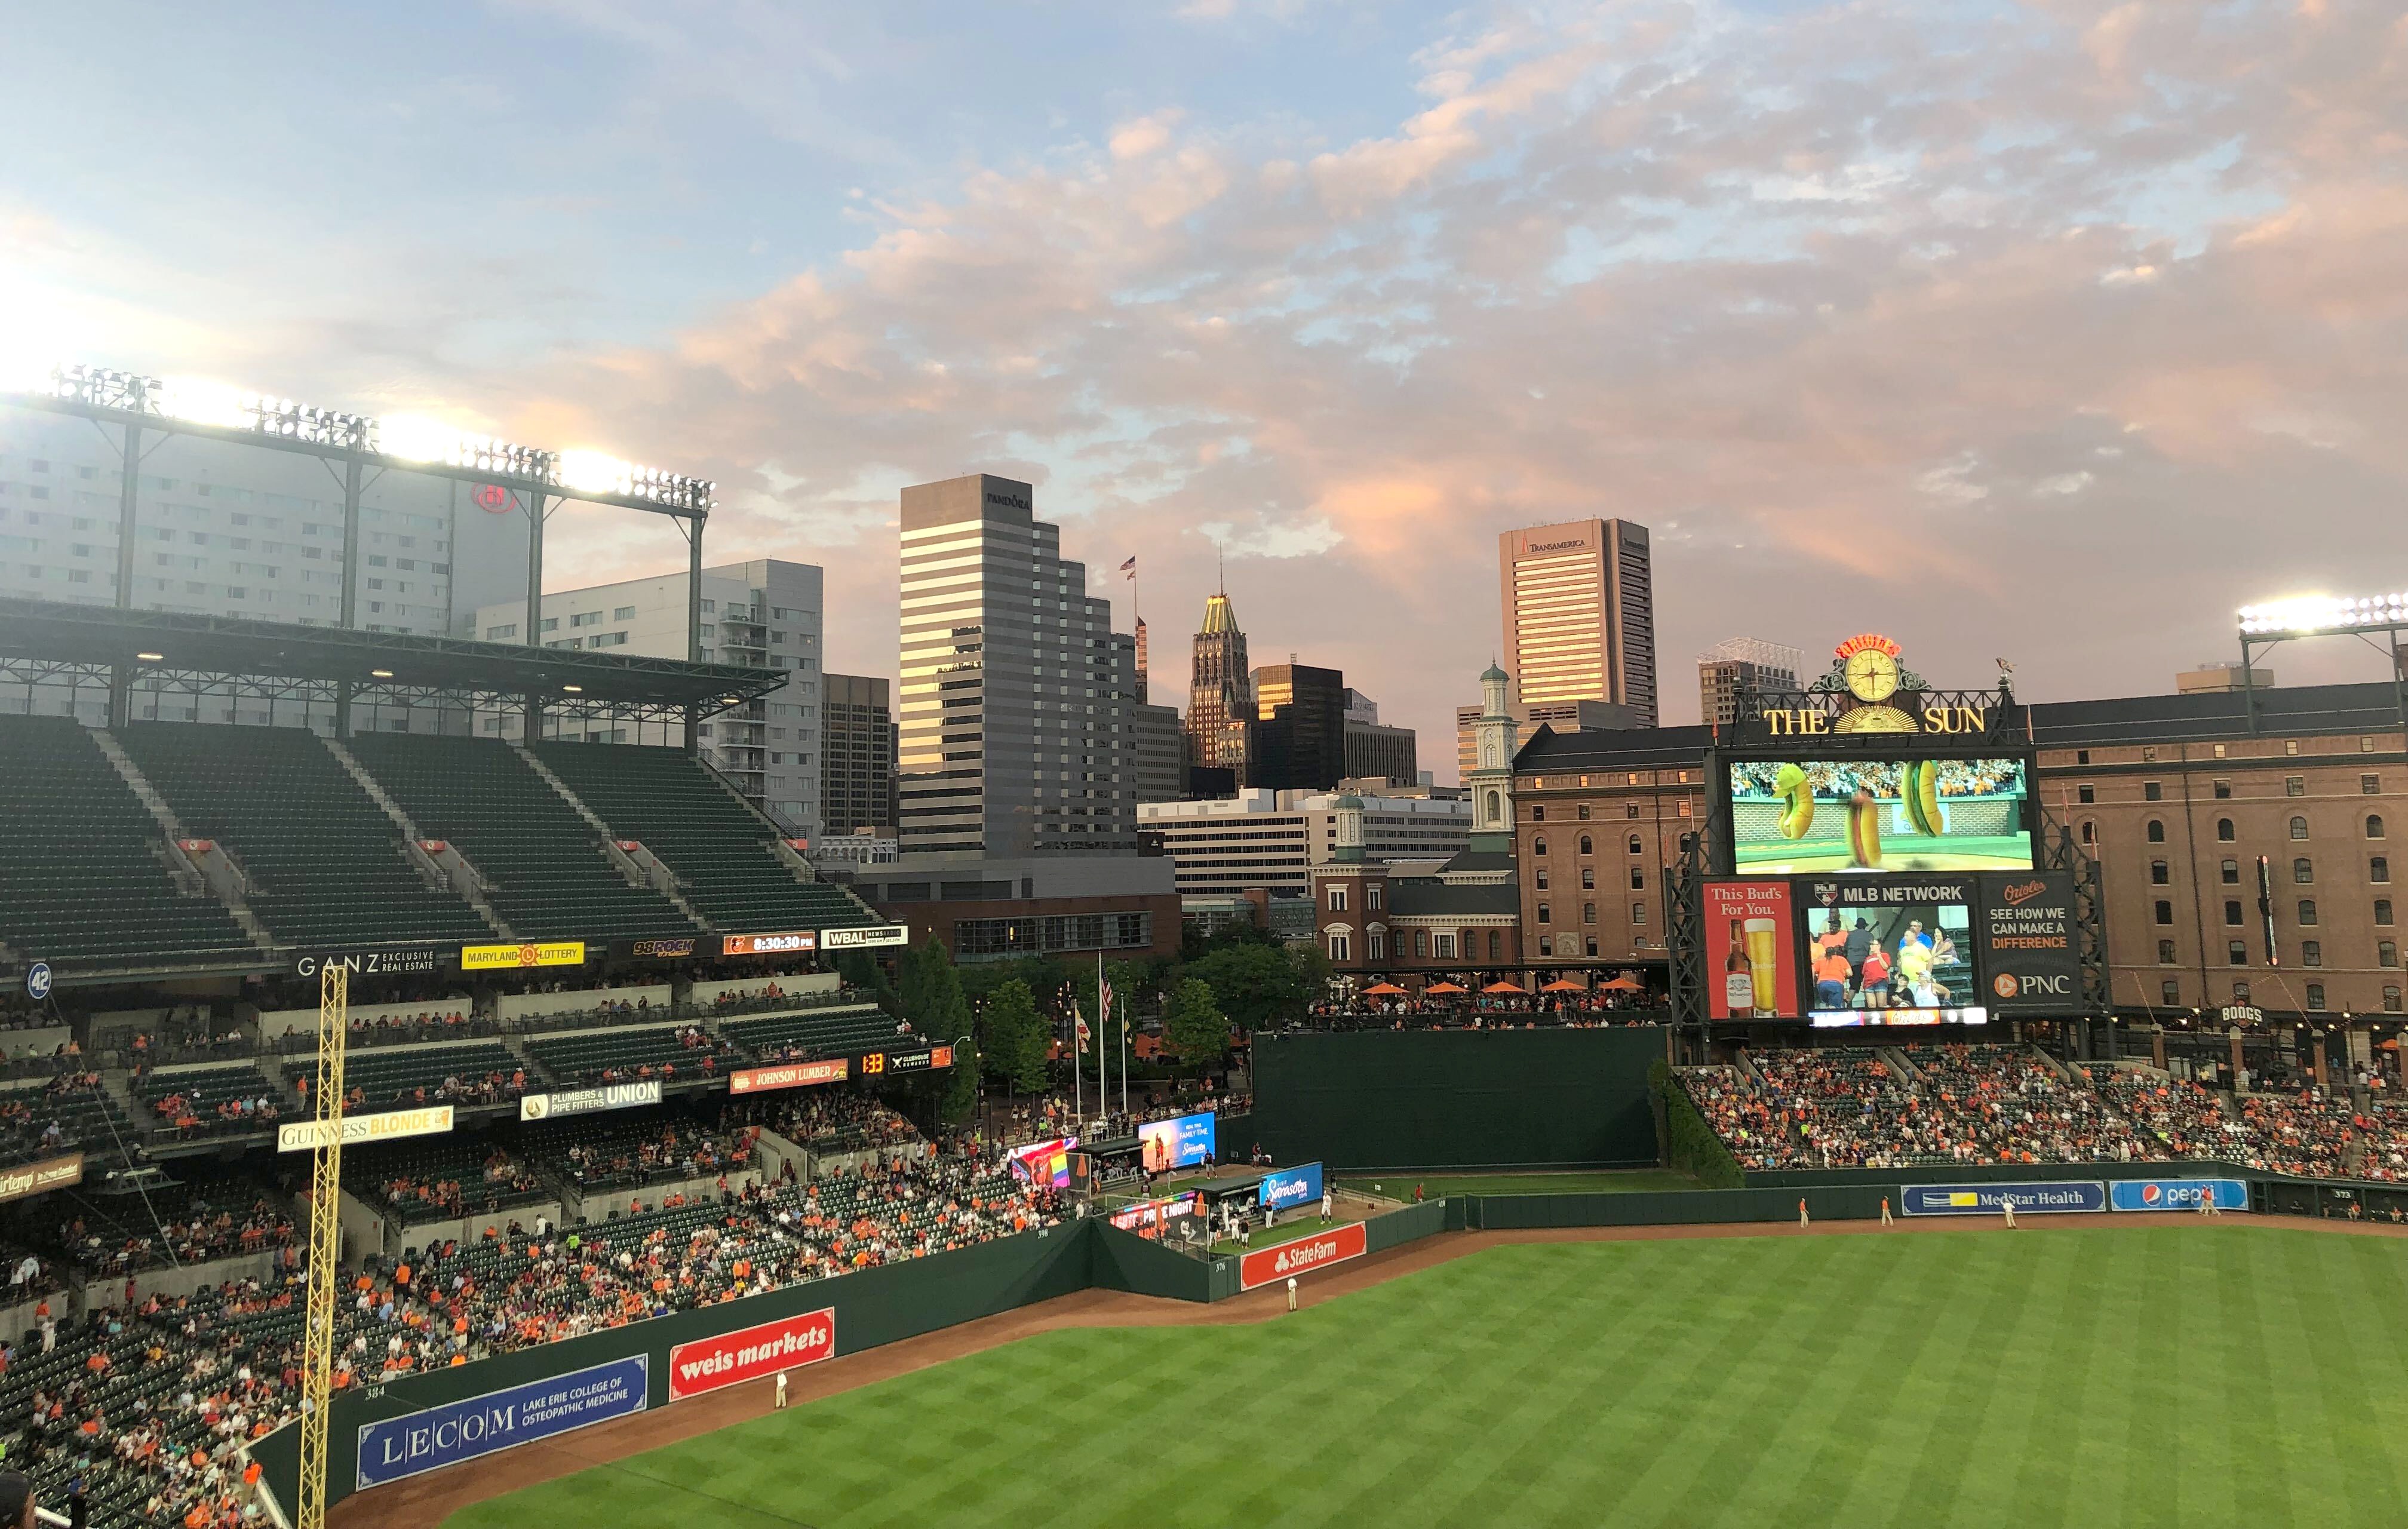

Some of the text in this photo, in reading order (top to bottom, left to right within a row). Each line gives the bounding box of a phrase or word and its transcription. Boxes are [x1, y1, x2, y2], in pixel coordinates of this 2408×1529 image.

[1834, 633, 1902, 659] ORIOLES
[1764, 707, 1985, 735] THE SUN
[1712, 887, 1782, 900] This Bud's
[1844, 885, 1963, 902] MLB NETWORK
[2004, 880, 2047, 902] Orioles
[1721, 902, 1775, 916] For You.
[1990, 907, 2065, 920] SEE HOW WE
[1992, 922, 2065, 934] CAN MAKE A
[754, 935, 813, 951] 8:30:30 PM
[830, 932, 865, 944] WBAL
[1992, 937, 2067, 949] DIFFERENCE
[382, 951, 434, 962] EXCLUSIVE
[468, 951, 517, 963] MARYLAND
[539, 948, 578, 959] LOTTERY
[297, 954, 379, 977] GANZ
[382, 961, 434, 972] REAL ESTATE
[32, 971, 49, 991] 42
[2019, 975, 2071, 994] PNC
[1870, 1012, 1881, 1024] 2
[2222, 1006, 2263, 1023] BOOG'S
[863, 1052, 884, 1074] 1:33
[902, 1059, 929, 1067] REWARDS
[903, 1053, 929, 1063] CLUBHOUSE
[756, 1070, 797, 1086] JOHNSON
[798, 1066, 831, 1080] LUMBER
[552, 1090, 596, 1104] PLUMBERS
[607, 1081, 659, 1104] UNION
[551, 1098, 604, 1113] PIPE FITTERS
[370, 1112, 431, 1135] BLONDE
[1180, 1130, 1196, 1140] FAMILY
[1268, 1177, 1307, 1202] Sarasota
[2167, 1184, 2215, 1206] pepi
[2334, 1190, 2351, 1199] 373
[1980, 1190, 2084, 1206] MedStar Health
[1143, 1205, 1168, 1224] PRE
[1169, 1199, 1194, 1218] NIGHT
[1037, 1229, 1049, 1239] 398
[1215, 1262, 1226, 1273] 376
[680, 1325, 827, 1381] weis markets
[365, 1384, 385, 1401] 384
[522, 1376, 623, 1414] LAKE ERIE COLLEGE OF
[521, 1387, 628, 1427] OSTEOPATHIC MEDICINE
